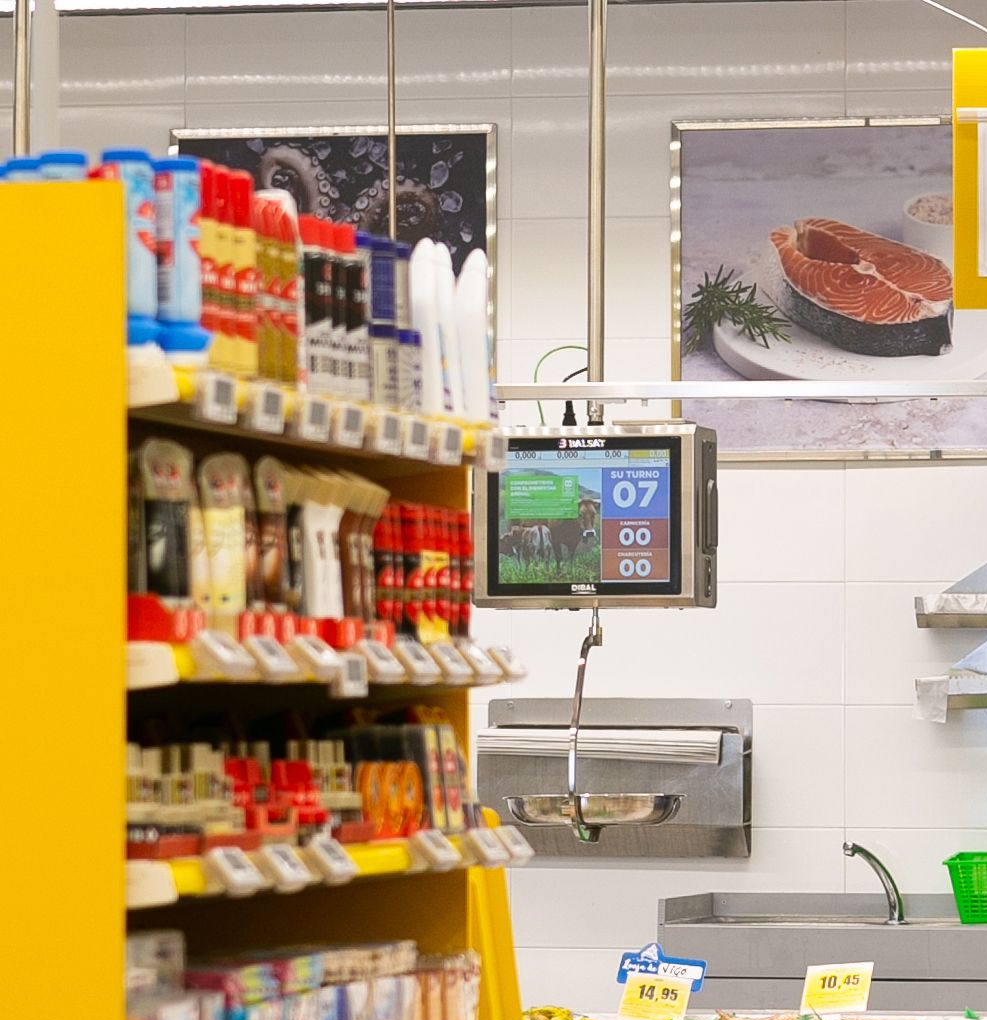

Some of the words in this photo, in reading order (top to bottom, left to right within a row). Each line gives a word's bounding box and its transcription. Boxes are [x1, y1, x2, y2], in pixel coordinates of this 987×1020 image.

[610, 471, 624, 479] SU
[626, 471, 660, 479] TURNO
[612, 480, 659, 509] 07
[618, 528, 652, 546] 00
[618, 558, 652, 577] 00
[820, 974, 860, 990] 10,45
[639, 984, 678, 1002] 14,95
